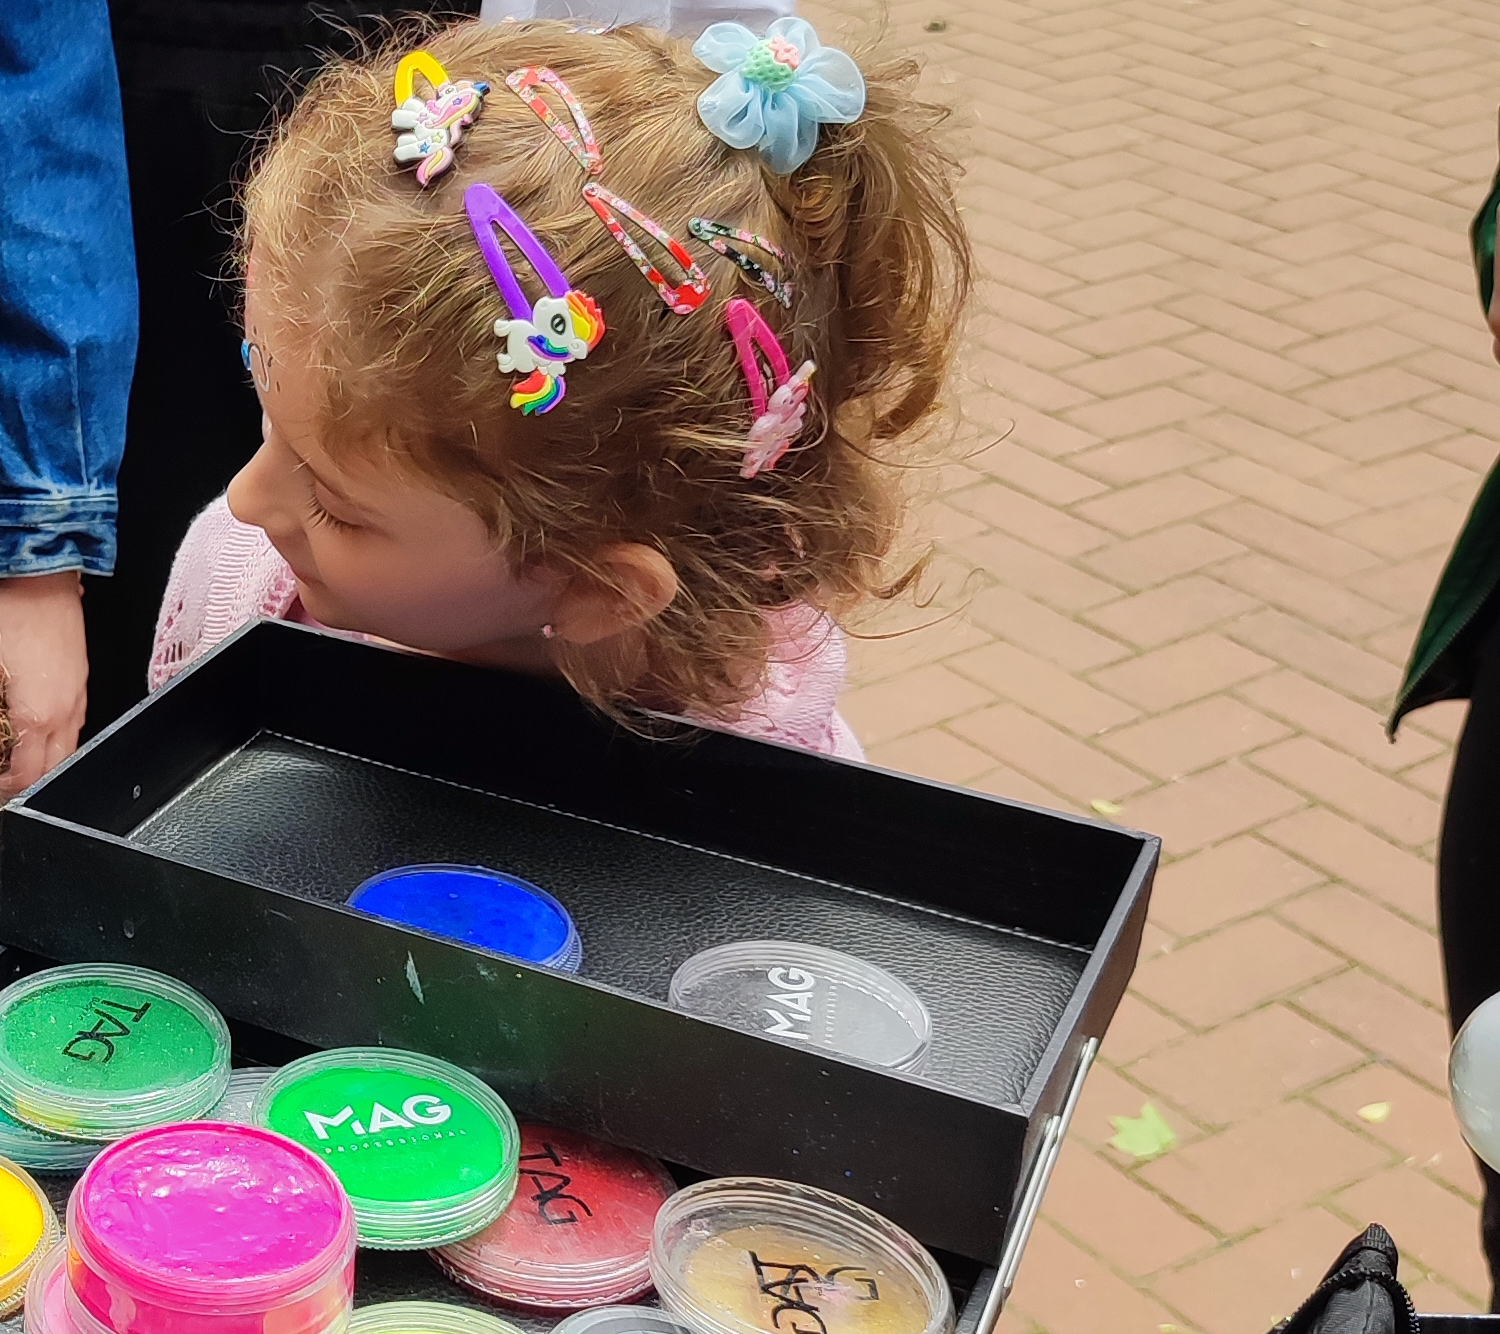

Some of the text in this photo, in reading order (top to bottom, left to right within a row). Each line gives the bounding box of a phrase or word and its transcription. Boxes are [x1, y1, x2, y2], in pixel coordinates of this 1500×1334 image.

[61, 999, 152, 1063] TAG
[763, 966, 815, 1040] MAG
[302, 1094, 452, 1140] MAG
[518, 1141, 593, 1226] TAG
